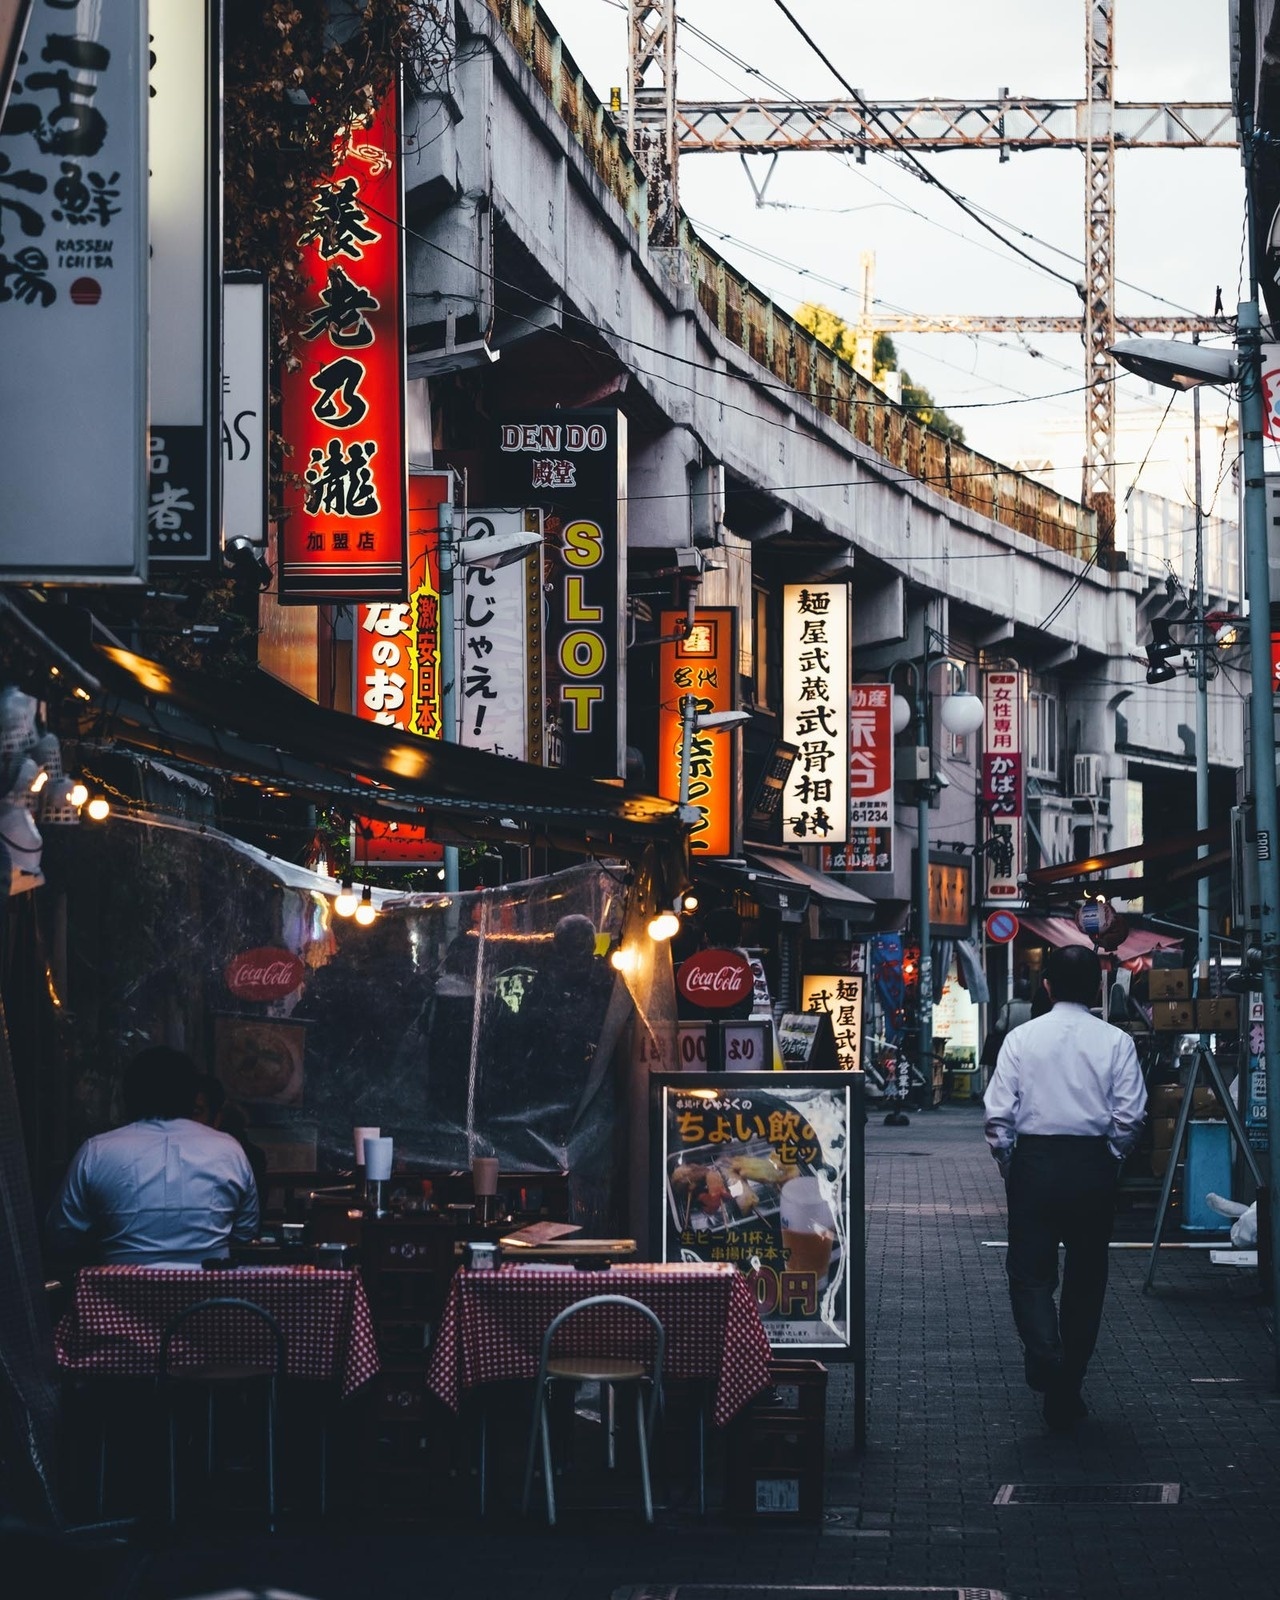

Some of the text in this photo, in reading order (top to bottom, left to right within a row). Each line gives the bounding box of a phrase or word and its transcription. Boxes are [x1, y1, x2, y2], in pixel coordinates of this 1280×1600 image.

[56, 239, 114, 253] KASSEN
[58, 255, 114, 269] ICHIBA
[501, 424, 608, 451] DEN DO
[306, 531, 376, 551] 加盟店
[562, 521, 607, 733] SLOT
[993, 687, 1013, 748] 女性専用
[234, 961, 294, 987] Coca-Cola
[686, 966, 745, 992] Coca-Cola
[729, 1038, 754, 1061] より
[898, 1062, 910, 1099] 営業中
[681, 1231, 775, 1246] 生ビール1杯と
